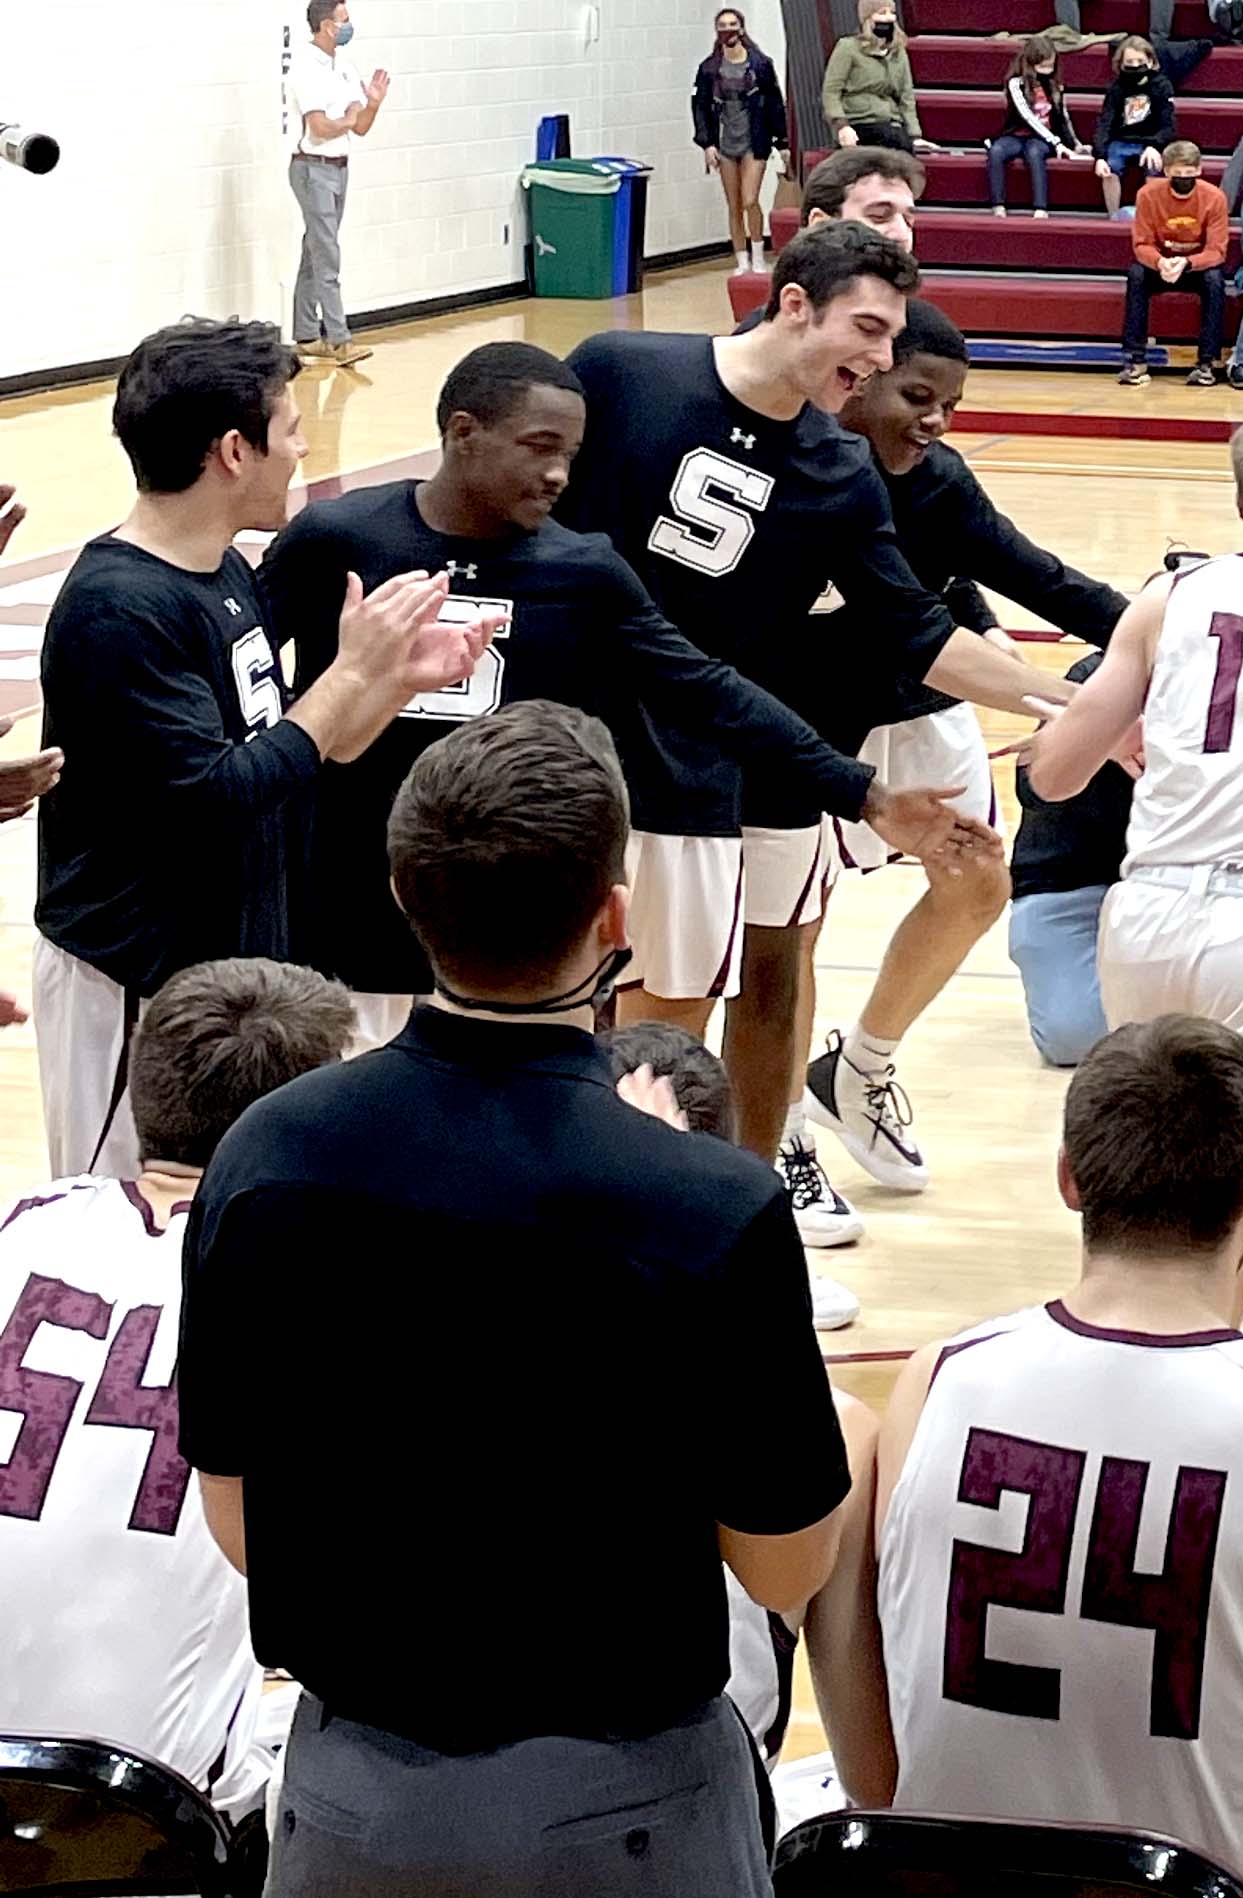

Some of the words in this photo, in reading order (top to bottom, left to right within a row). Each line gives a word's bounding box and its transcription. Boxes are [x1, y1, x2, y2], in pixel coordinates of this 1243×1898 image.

[647, 446, 776, 577] S
[0, 1271, 192, 1537] 54
[942, 1426, 1228, 1740] 24
